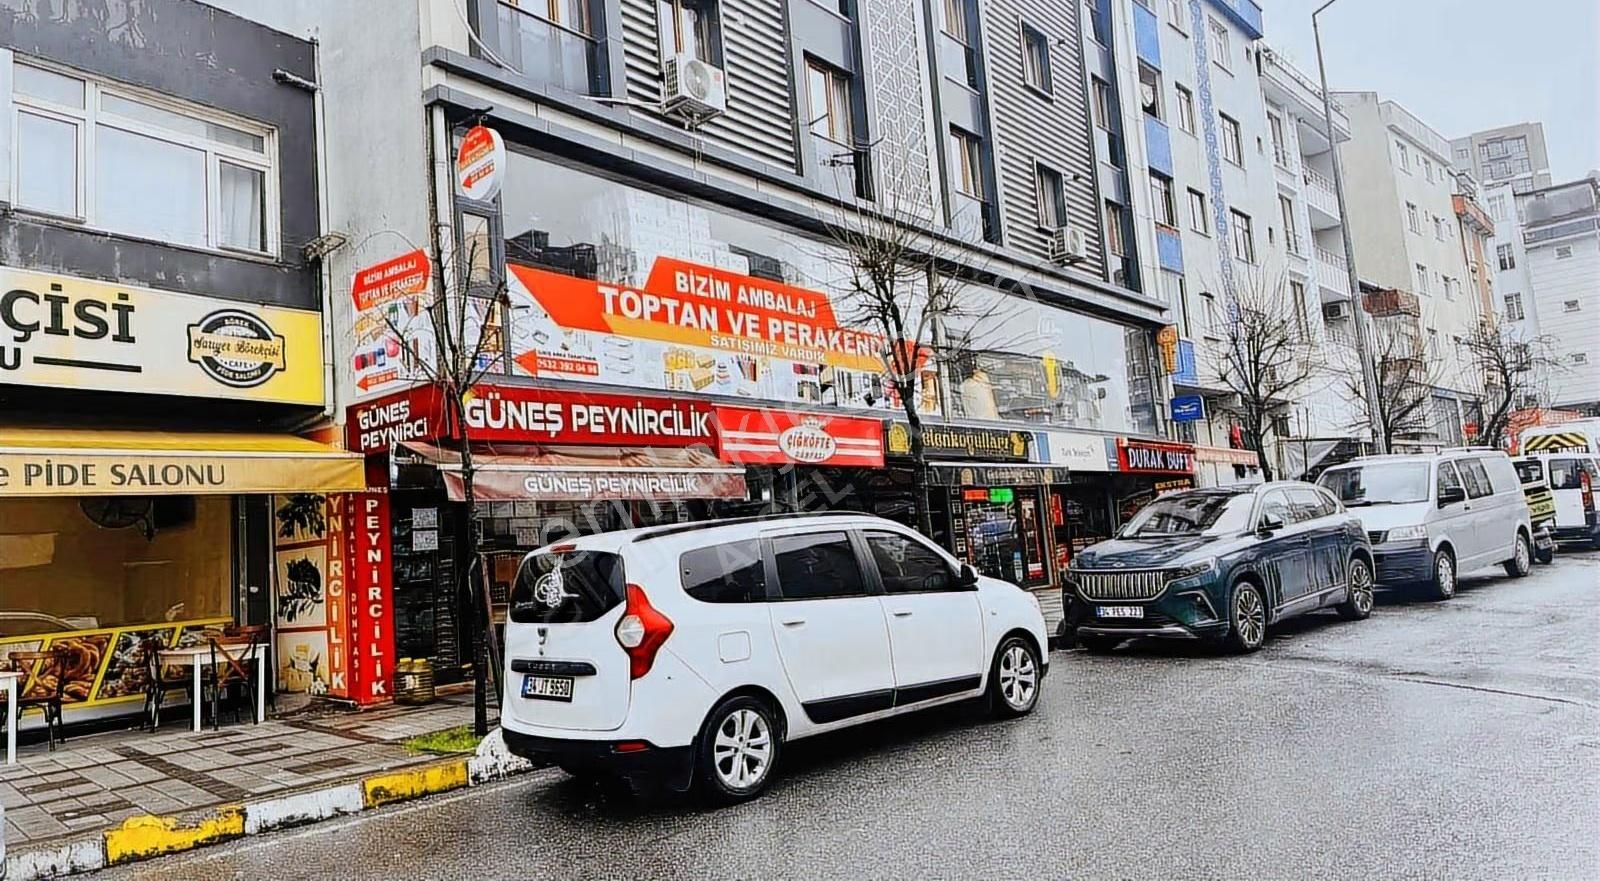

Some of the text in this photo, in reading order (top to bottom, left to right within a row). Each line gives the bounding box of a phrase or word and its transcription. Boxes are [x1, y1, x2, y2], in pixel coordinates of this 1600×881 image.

[675, 269, 816, 319] BİZİM AMBALAJ
[597, 284, 890, 360] TOPTAN VE PERAKEND
[359, 400, 411, 430] GÜNEŞ
[465, 393, 711, 438] GÜNEŞ PEYNİRCİLİK
[24, 460, 97, 486] PİDE
[110, 463, 226, 486] SALONU
[1128, 448, 1165, 468] DURAK
[524, 473, 699, 497] GÜNEŞ PEYNİRCİLİK
[366, 499, 387, 696] PEYNİRCİLİK
